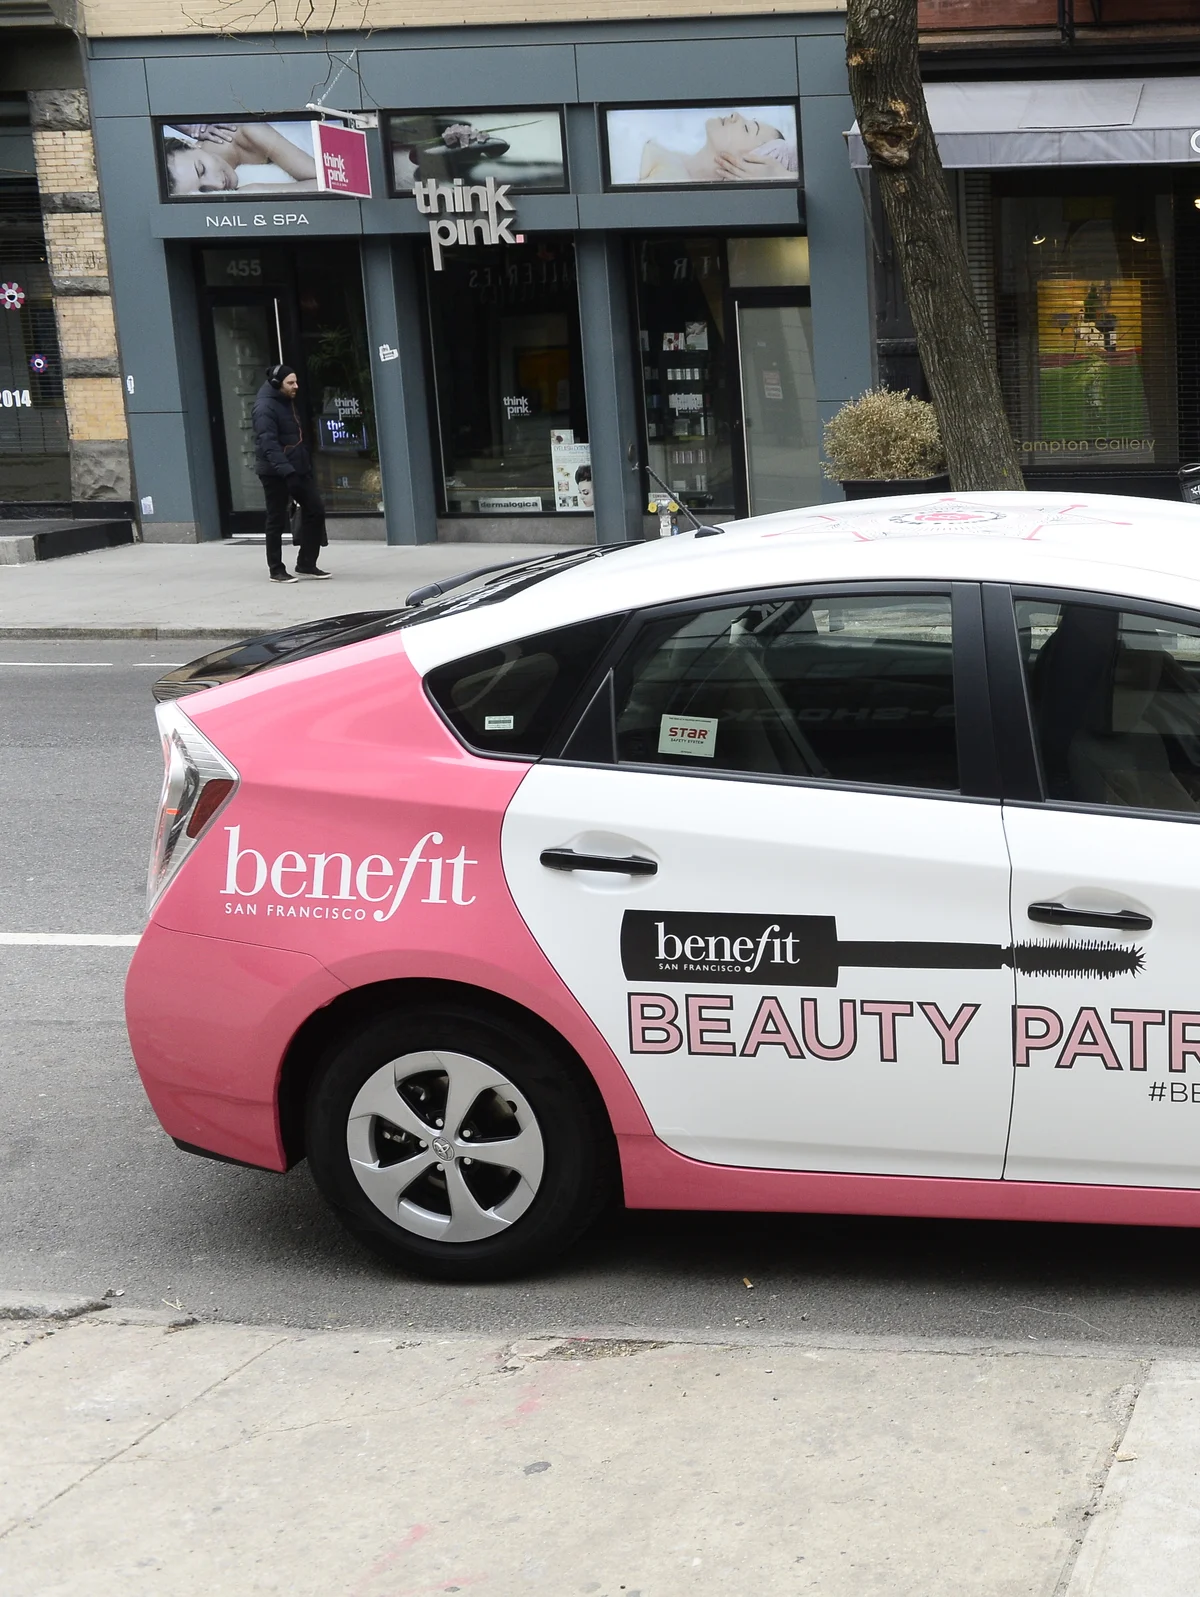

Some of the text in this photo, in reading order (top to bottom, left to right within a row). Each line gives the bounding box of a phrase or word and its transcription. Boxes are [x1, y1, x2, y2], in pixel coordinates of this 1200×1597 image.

[323, 152, 345, 170] think
[412, 176, 516, 213] think
[206, 213, 310, 227] NAIL & SPA
[227, 260, 262, 276] 455
[334, 397, 359, 407] think
[503, 396, 529, 405] think
[1094, 436, 1156, 453] Gallery
[480, 501, 538, 509] dermalogica
[219, 824, 478, 922] benefit
[225, 902, 366, 921] SAN FRANCISCO
[654, 921, 800, 973] benefit
[659, 962, 741, 973] SAN FRANCISCO
[627, 992, 981, 1065] BEAUTY
